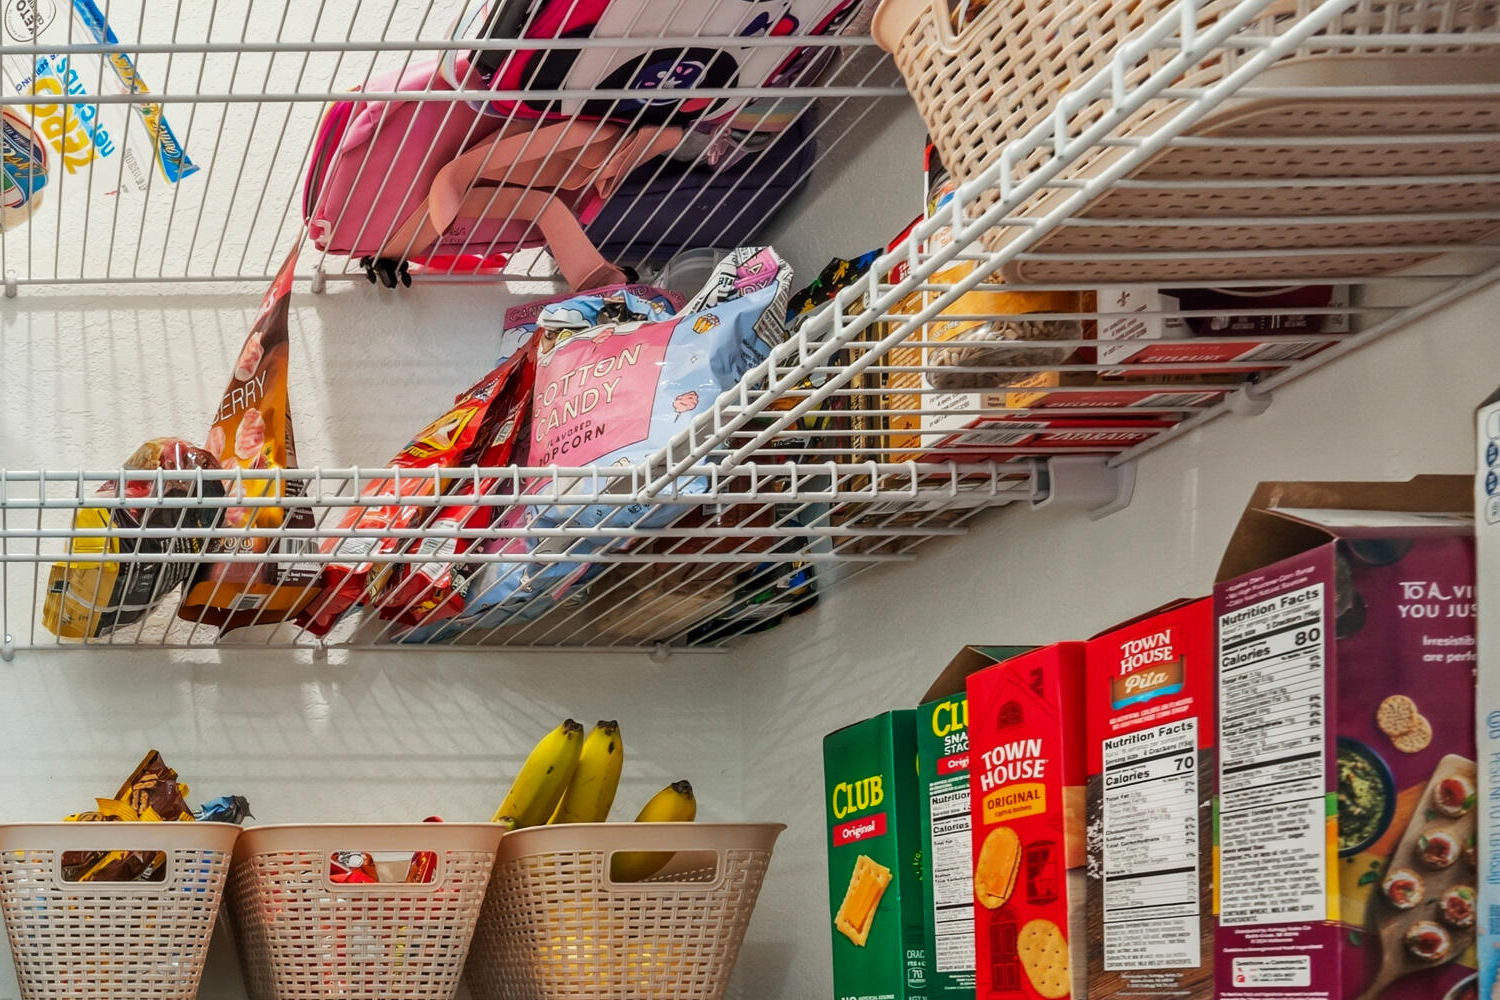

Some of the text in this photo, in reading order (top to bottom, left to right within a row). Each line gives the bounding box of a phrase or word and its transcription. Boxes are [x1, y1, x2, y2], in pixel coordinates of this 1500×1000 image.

[26, 77, 98, 174] ZERO
[535, 376, 622, 444] CANDY
[1221, 587, 1320, 628] Nutrition Facts
[1398, 604, 1440, 619] YOU
[1120, 628, 1172, 659] TOWN
[1221, 627, 1321, 668] Calories 80
[1119, 645, 1174, 676] HOUSE
[1124, 669, 1170, 694] Pita
[931, 699, 969, 738] CLU
[1104, 719, 1195, 751] Nutrition Facts
[981, 738, 1043, 772] TOWN
[1105, 755, 1195, 787] Calories 70
[980, 759, 1046, 792] HOUSE
[832, 774, 885, 820] CLUB
[987, 787, 1041, 811] ORIGINAL
[842, 819, 876, 840] Original
[932, 821, 971, 835] Calories
